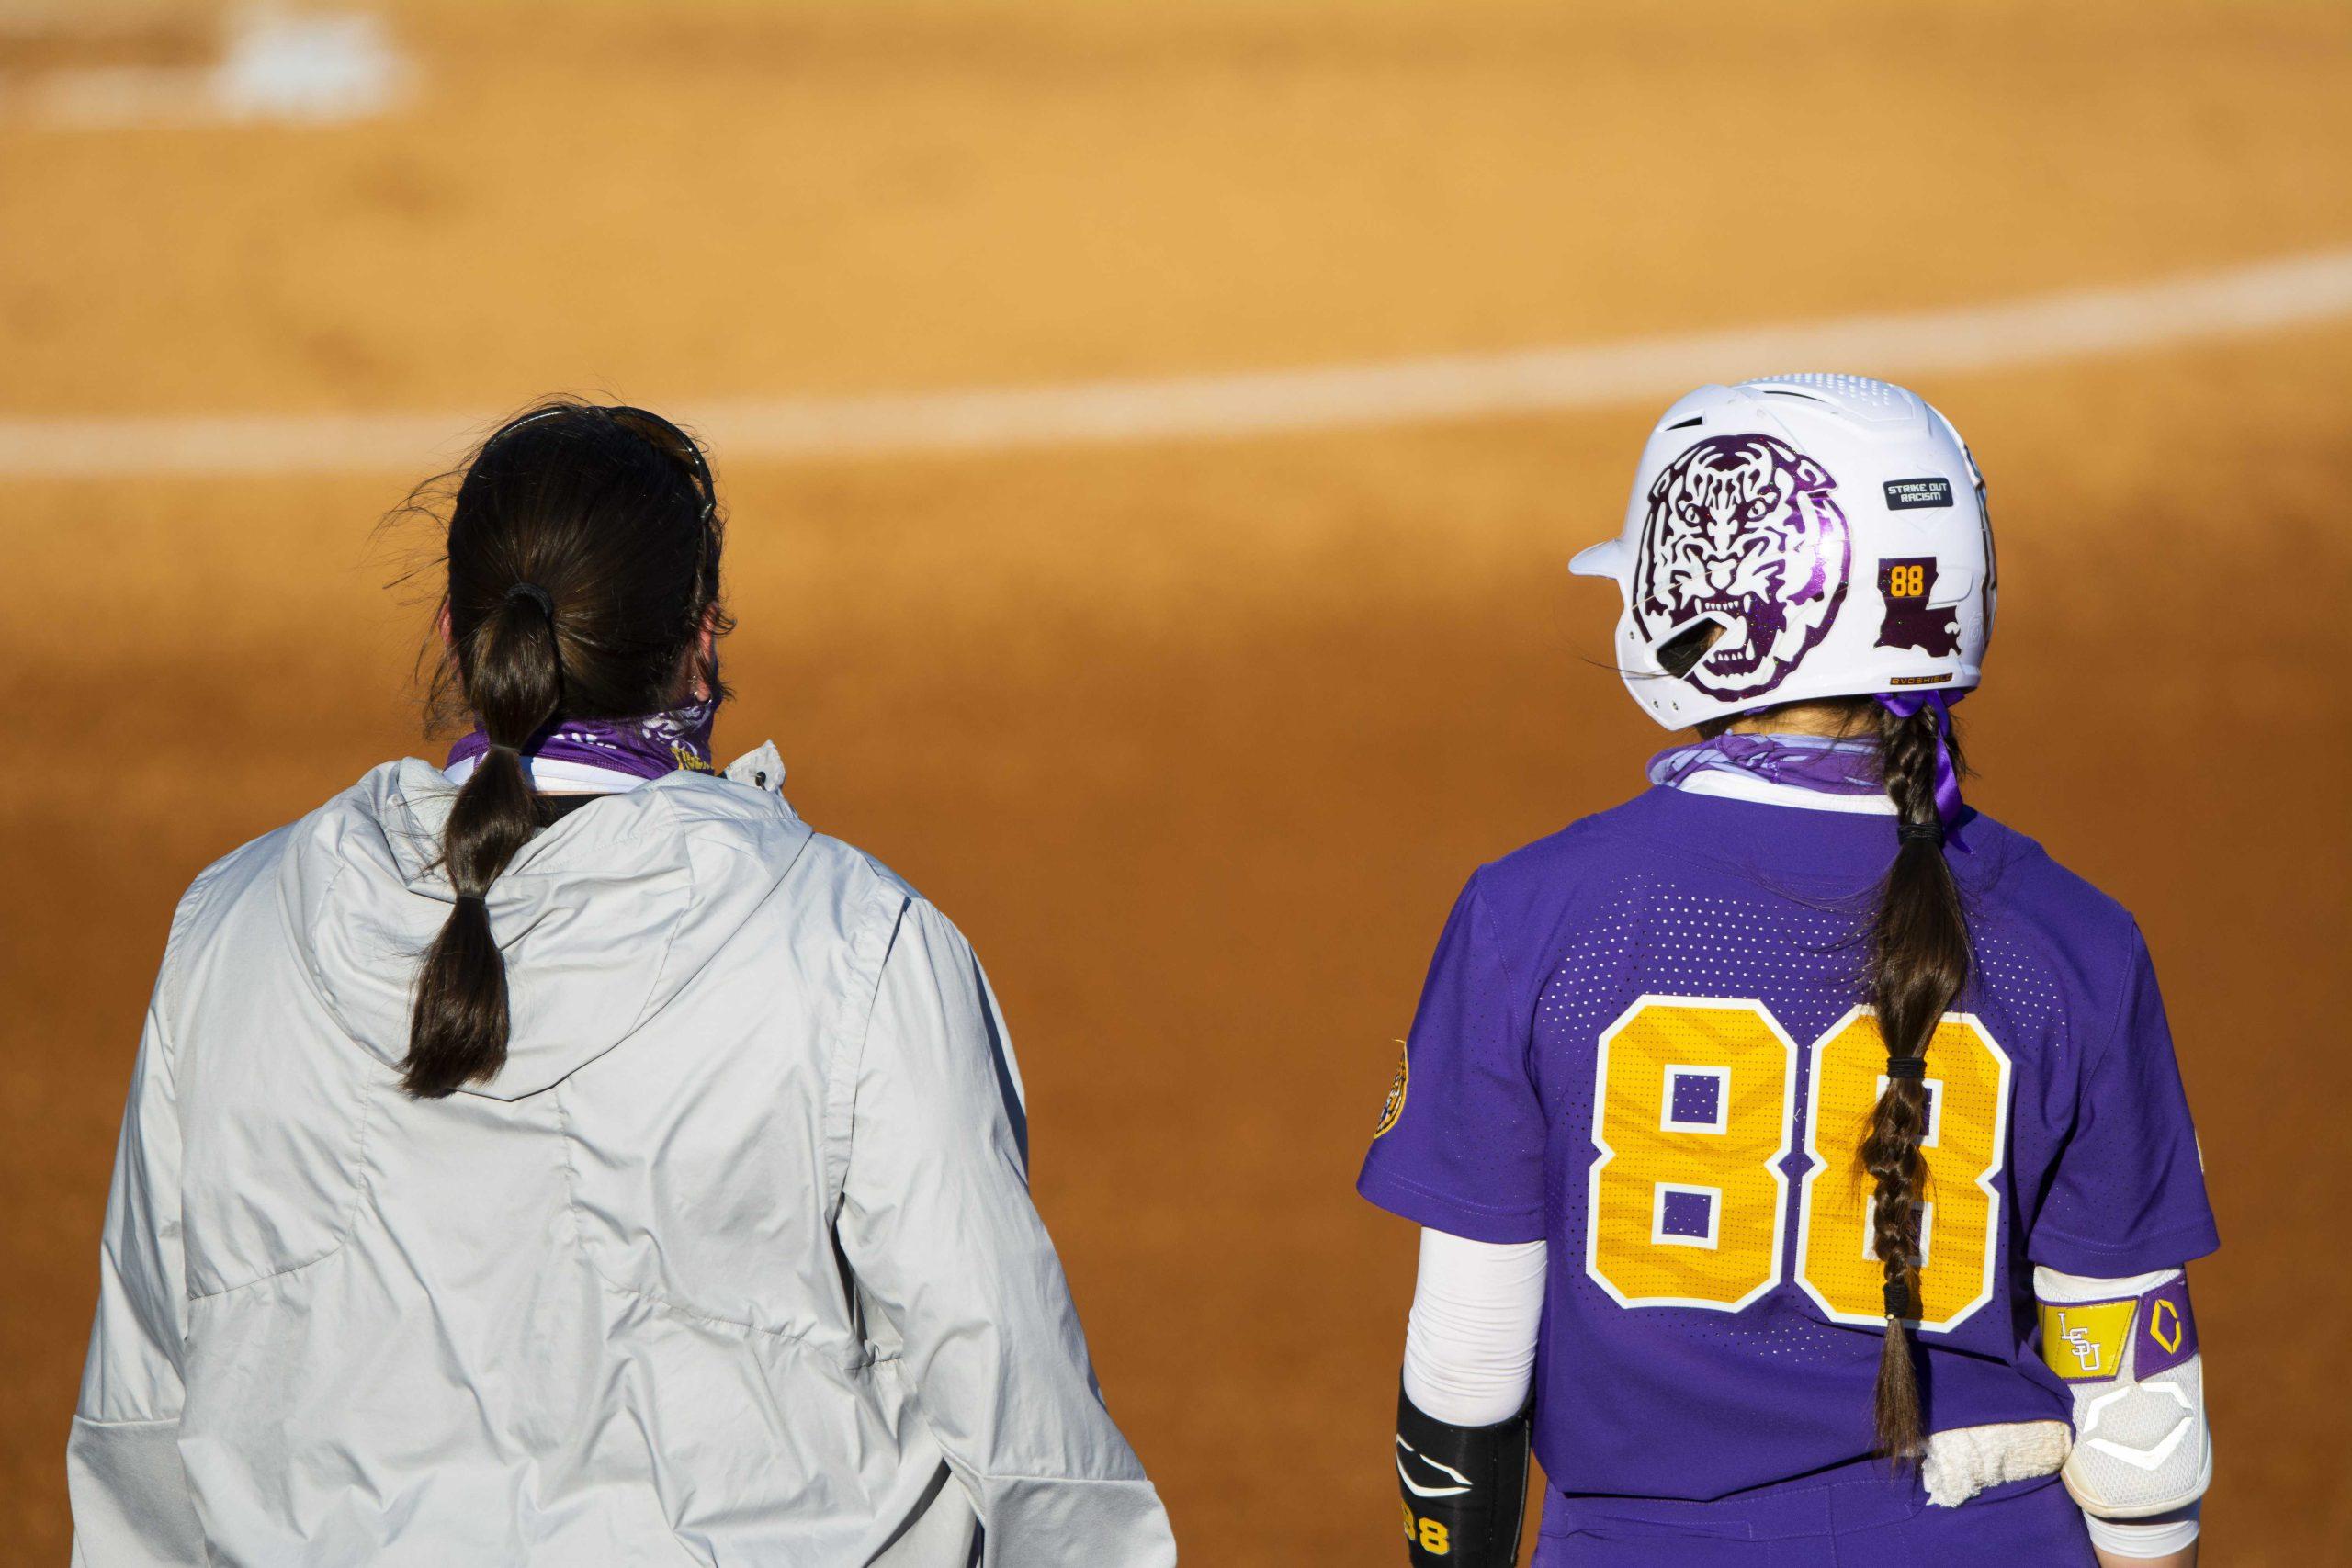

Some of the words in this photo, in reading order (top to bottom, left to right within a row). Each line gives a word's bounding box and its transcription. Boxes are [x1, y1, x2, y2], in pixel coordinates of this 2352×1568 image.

[1887, 483, 1928, 495] STRIKE
[1928, 482, 1948, 491] OUT
[1900, 491, 1942, 502] RACISM
[1891, 564, 1924, 597] 88
[1586, 994, 2012, 1333] 88
[2057, 1312, 2102, 1371] LSU
